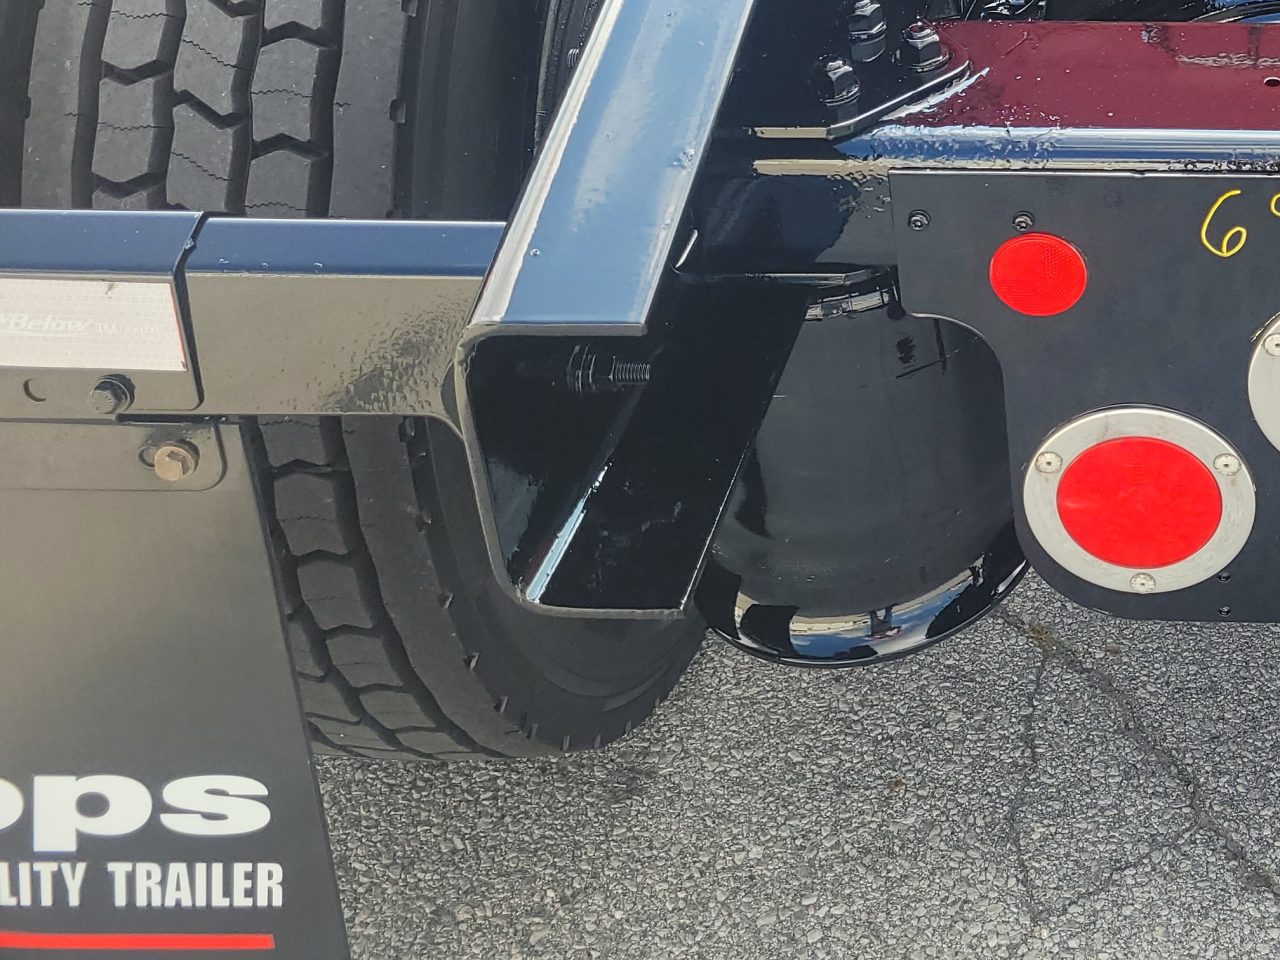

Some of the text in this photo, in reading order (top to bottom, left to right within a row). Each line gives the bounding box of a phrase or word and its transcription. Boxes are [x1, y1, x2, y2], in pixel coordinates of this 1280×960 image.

[0, 312, 94, 332] Below
[0, 774, 271, 852] ps
[107, 861, 284, 907] TRAILER
